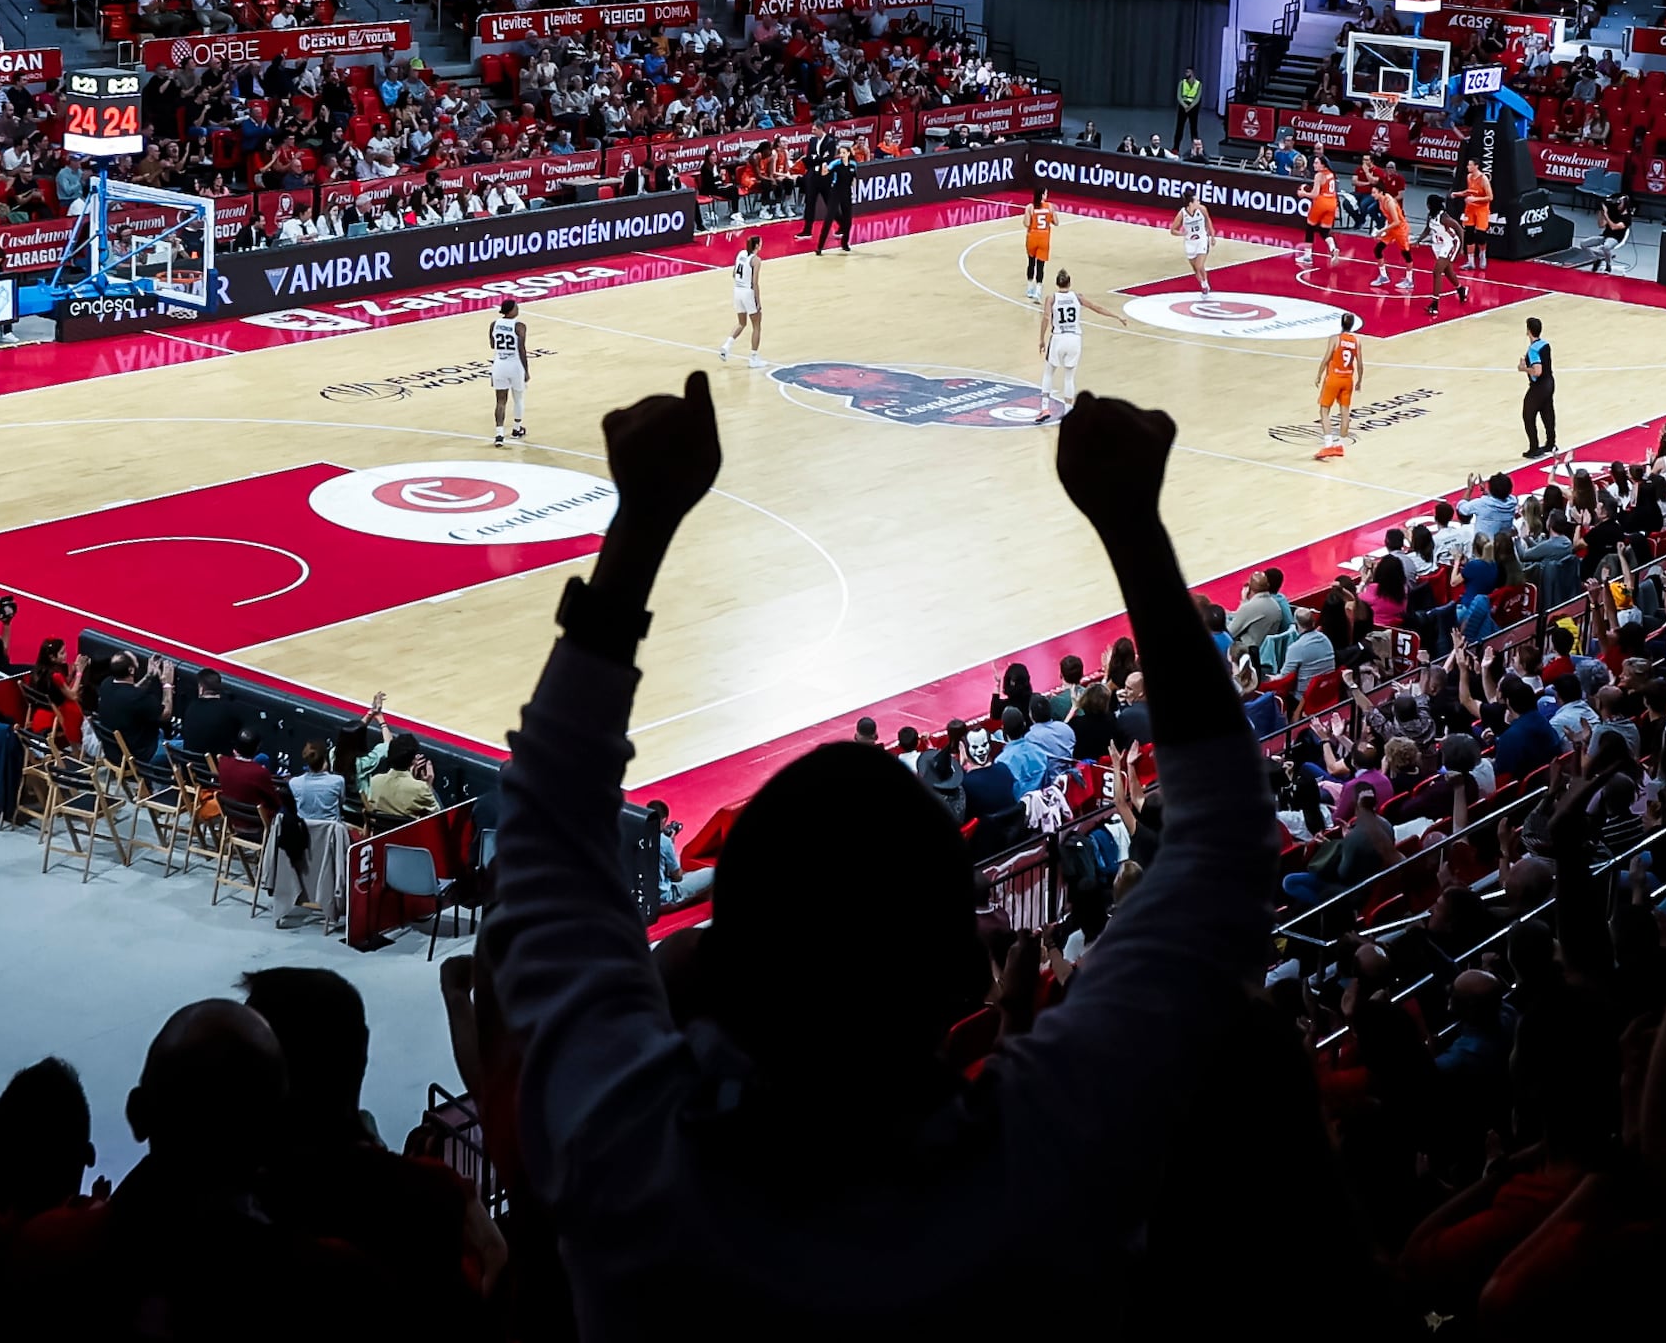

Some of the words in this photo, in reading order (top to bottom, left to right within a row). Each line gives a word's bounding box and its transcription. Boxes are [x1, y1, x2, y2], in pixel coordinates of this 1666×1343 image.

[192, 38, 261, 66] ORBE
[1468, 72, 1490, 90] ZGZ
[68, 103, 98, 136] 24
[103, 105, 139, 137] 24
[1020, 113, 1054, 127] ZARAGOZA
[1289, 114, 1352, 136] Casademont
[1295, 129, 1346, 148] ZARAGOZA
[541, 157, 598, 176] Casademont
[1539, 147, 1610, 169] Casademont
[947, 157, 1015, 189] AMBAR
[1033, 158, 1076, 178] CON
[1079, 151, 1153, 193] LÚPULO
[1232, 190, 1312, 218] MOLIDO
[1036, 214, 1046, 230] 5
[419, 244, 462, 271] CON
[469, 233, 543, 264] LÚPULO
[546, 217, 611, 251] RECIÉN
[614, 210, 685, 241] MOLIDO
[287, 252, 394, 296] AMBAR
[736, 263, 744, 279] 4
[343, 262, 624, 318] Zaragoza
[74, 295, 139, 316] endesa
[1057, 306, 1077, 324] 13
[495, 333, 516, 351] 22
[1342, 349, 1351, 368] 9
[448, 485, 617, 541] Casademont
[1396, 632, 1412, 657] 5
